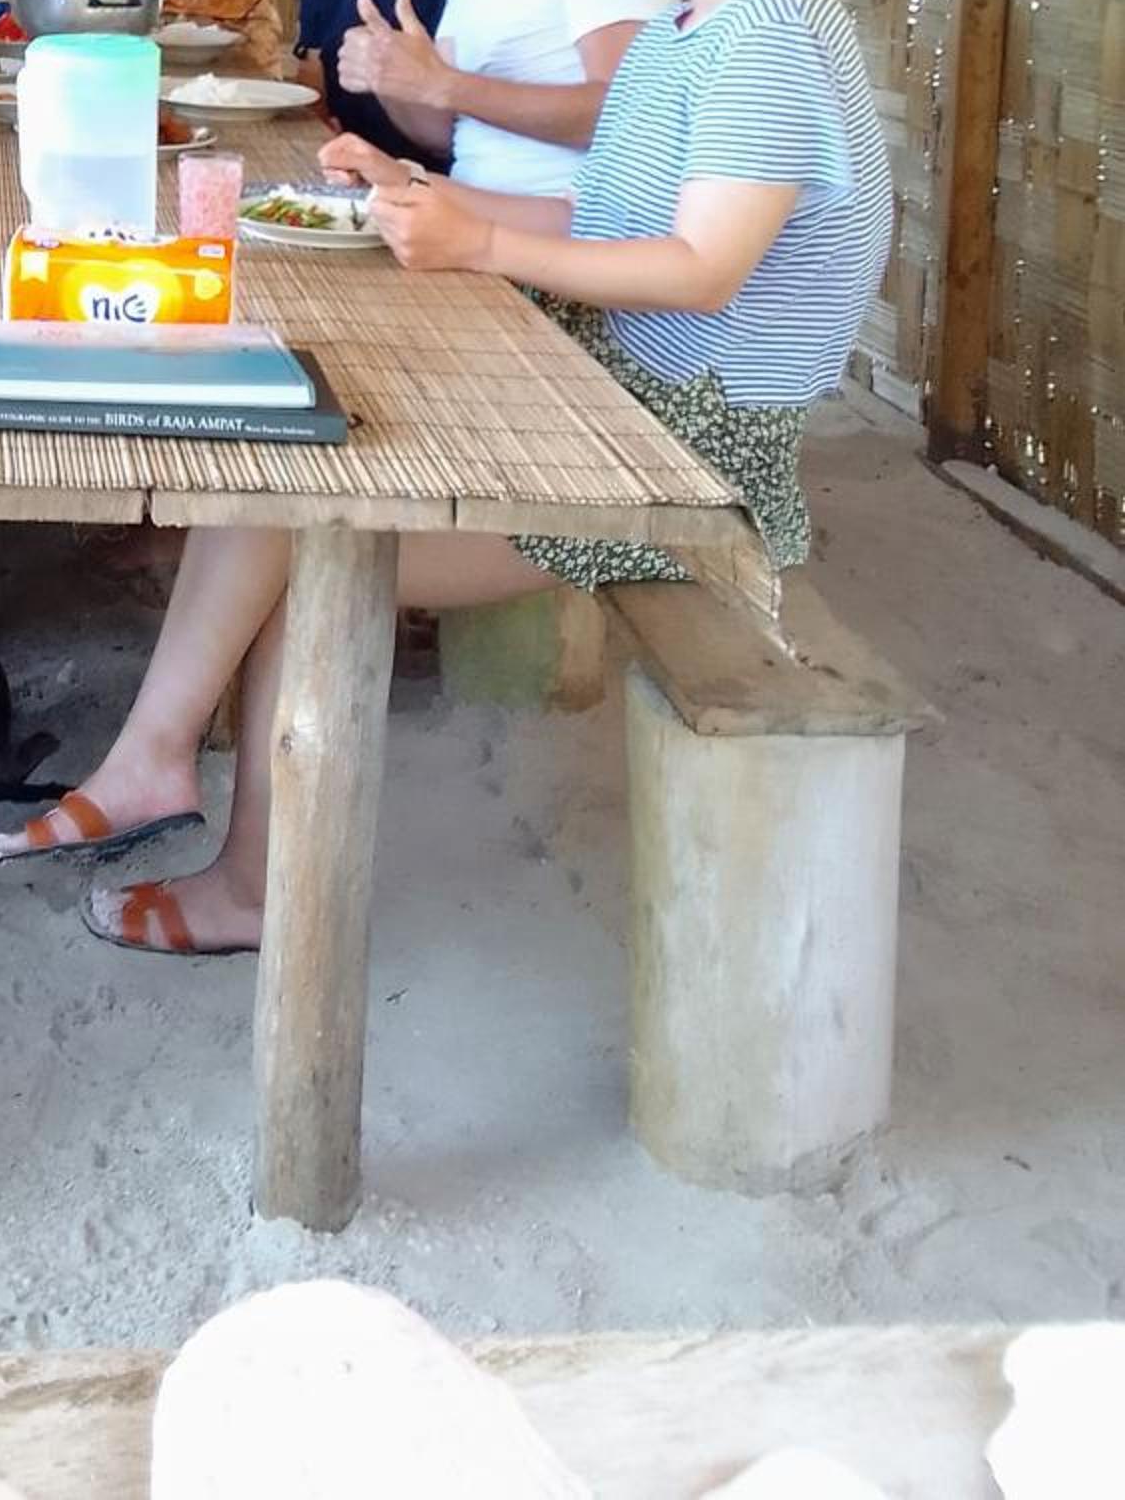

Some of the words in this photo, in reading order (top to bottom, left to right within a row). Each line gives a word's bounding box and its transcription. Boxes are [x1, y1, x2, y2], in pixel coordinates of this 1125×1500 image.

[104, 412, 145, 427] BIRDS
[162, 414, 196, 431] RAJA
[198, 416, 245, 431] AMPAT
